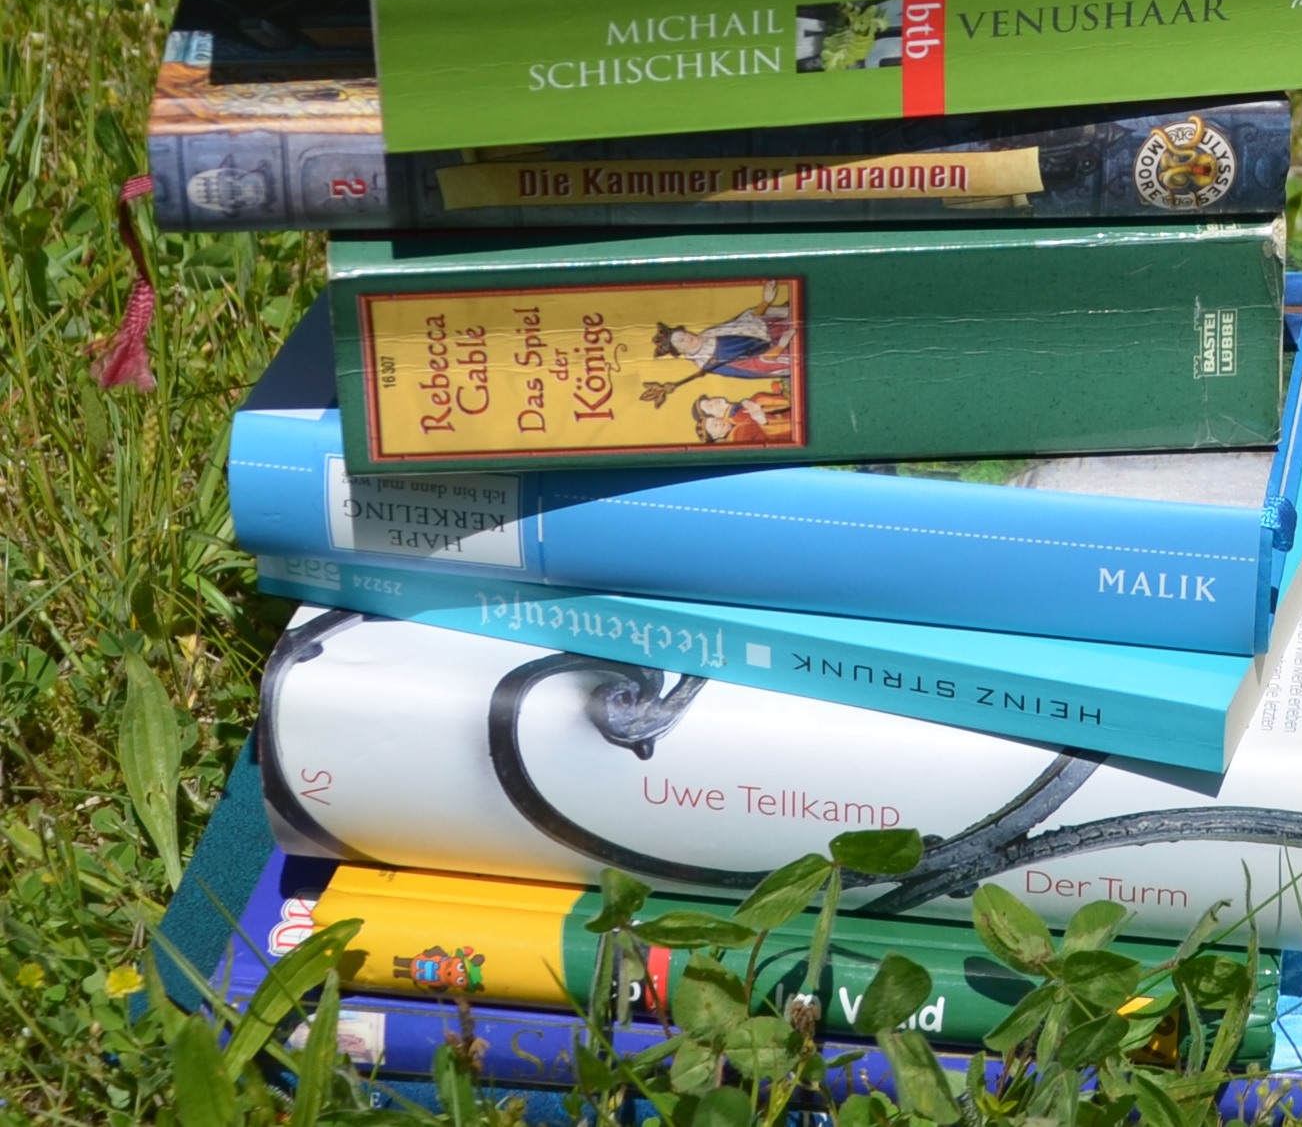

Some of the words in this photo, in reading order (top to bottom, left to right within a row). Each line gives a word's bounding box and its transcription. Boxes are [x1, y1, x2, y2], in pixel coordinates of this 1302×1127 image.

[606, 9, 783, 46] MICHAIL
[905, 2, 942, 59] btb
[528, 47, 782, 92] SCHISCHKIN
[519, 168, 571, 197] Die
[582, 164, 724, 196] Kammer
[731, 163, 785, 193] der
[794, 162, 969, 193] Pharaonen
[1138, 139, 1164, 201] MOORE
[1199, 131, 1232, 204] ULYSSES
[513, 306, 547, 368] Spiel
[1203, 313, 1216, 373] BASTEI
[420, 314, 455, 435] Rebecca
[456, 323, 491, 416] Gablé
[547, 349, 569, 381] der
[573, 312, 618, 423] Könige
[518, 381, 546, 434] Das
[377, 479, 405, 493] mal
[411, 482, 448, 499] dann
[452, 486, 477, 502] bin
[482, 489, 506, 505] Ich
[342, 499, 505, 533] KERKELING
[388, 528, 462, 553] HAPE
[352, 574, 403, 596] 25224
[1098, 568, 1217, 603] MALIK
[480, 592, 724, 669] fleckenteufel
[793, 652, 955, 698] STRUNK
[975, 686, 1101, 725] HEINZ
[299, 767, 333, 806] SV
[642, 777, 725, 811] Uwe
[736, 785, 901, 830] Tellkamp
[1025, 870, 1091, 898] Der
[1098, 877, 1189, 908] Turm
